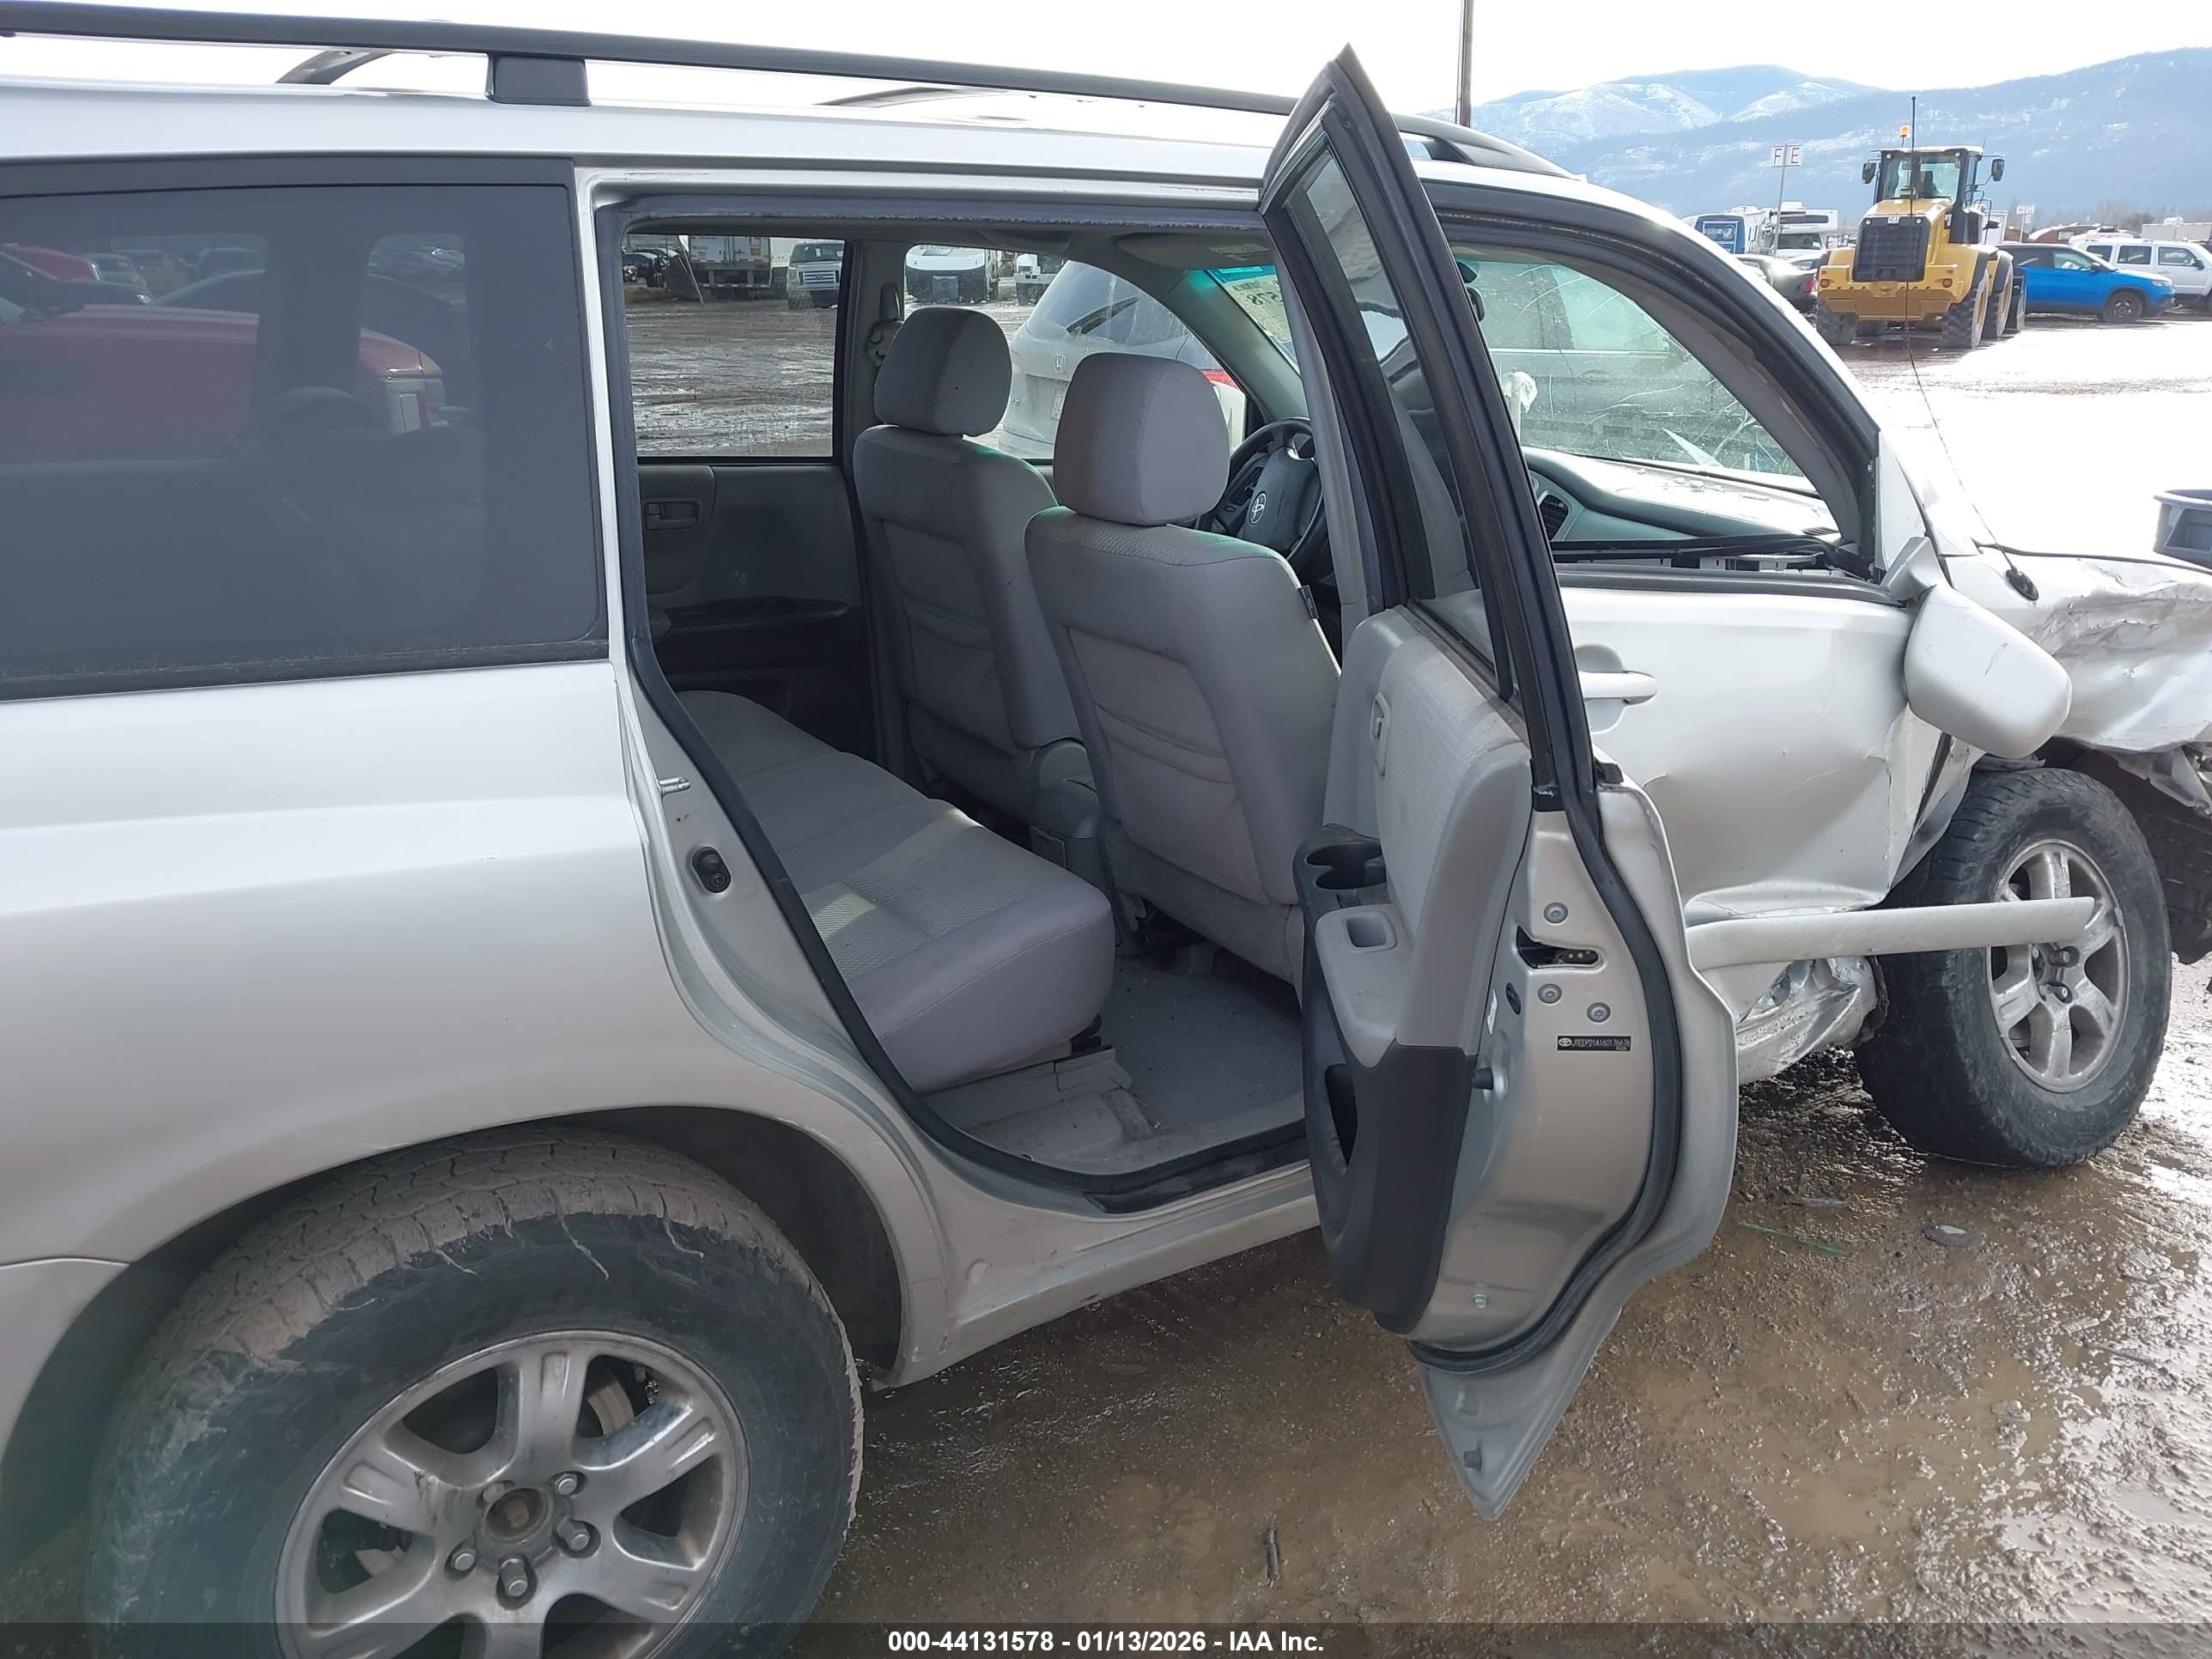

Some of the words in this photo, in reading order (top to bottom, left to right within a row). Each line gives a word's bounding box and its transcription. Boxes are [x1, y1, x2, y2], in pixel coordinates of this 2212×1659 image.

[1773, 148, 1783, 165] F
[1790, 147, 1800, 164] E
[1887, 216, 1900, 224] CAT
